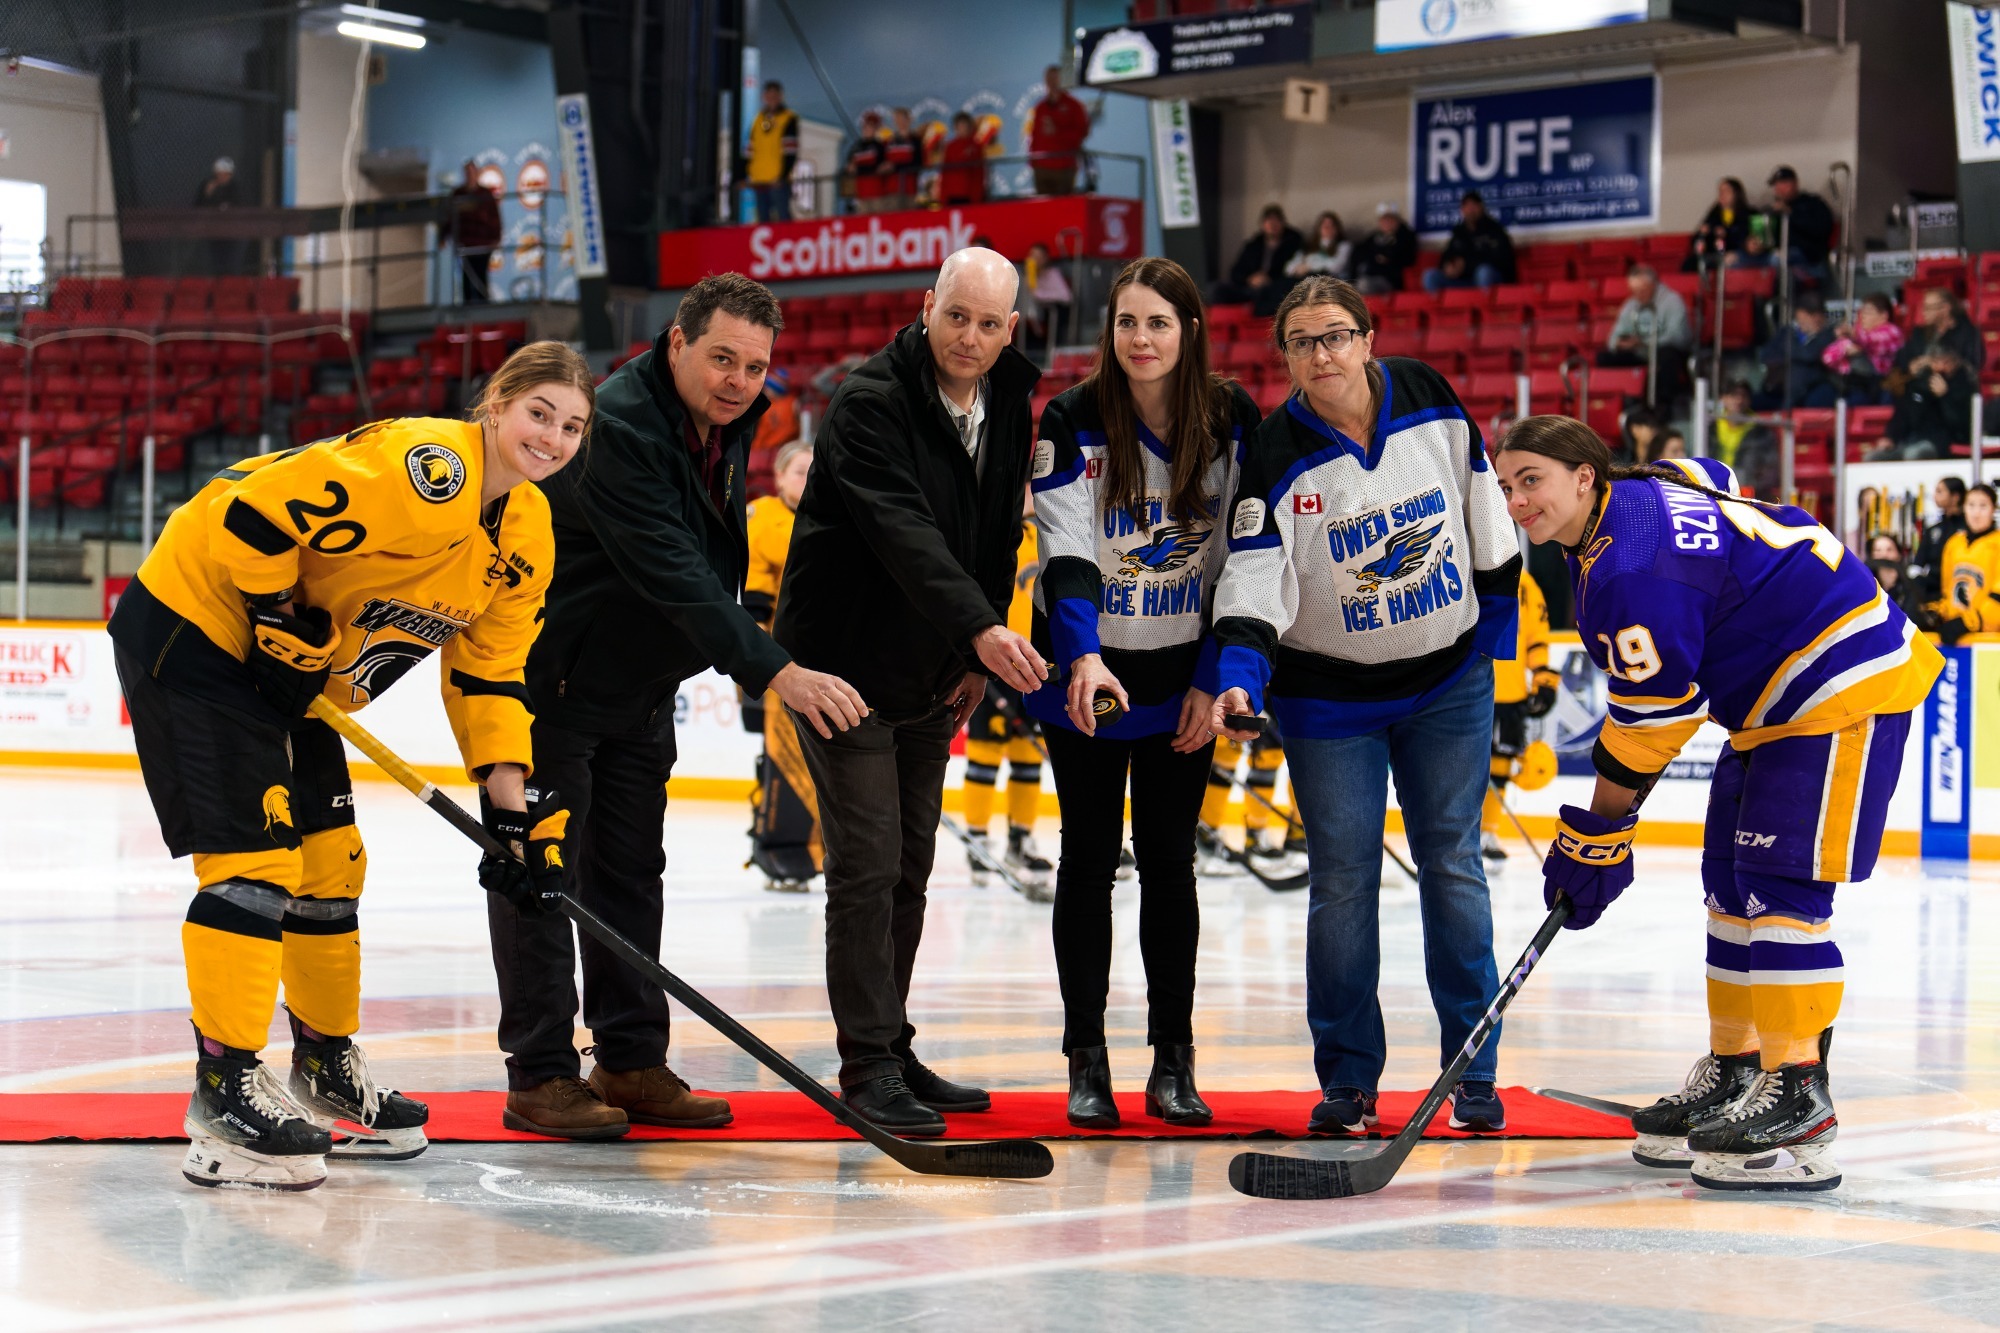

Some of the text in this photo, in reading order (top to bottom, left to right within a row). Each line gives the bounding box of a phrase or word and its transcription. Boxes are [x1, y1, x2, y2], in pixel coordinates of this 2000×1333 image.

[1298, 86, 1317, 115] T
[1429, 101, 1476, 127] Alex
[1426, 116, 1572, 183] RUFF
[1569, 152, 1594, 172] MP
[750, 209, 975, 278] Scotiabank
[411, 456, 432, 495] WATERLOO
[428, 447, 461, 494] UNIVERSITY OF
[285, 480, 367, 554] 20
[1327, 486, 1446, 564] OWEN SOUND
[1340, 536, 1463, 633] ICE HAWKS
[1597, 623, 1663, 684] 19
[498, 824, 523, 833] CCM
[1558, 829, 1637, 861] CCM
[1746, 903, 1767, 917] adidas
